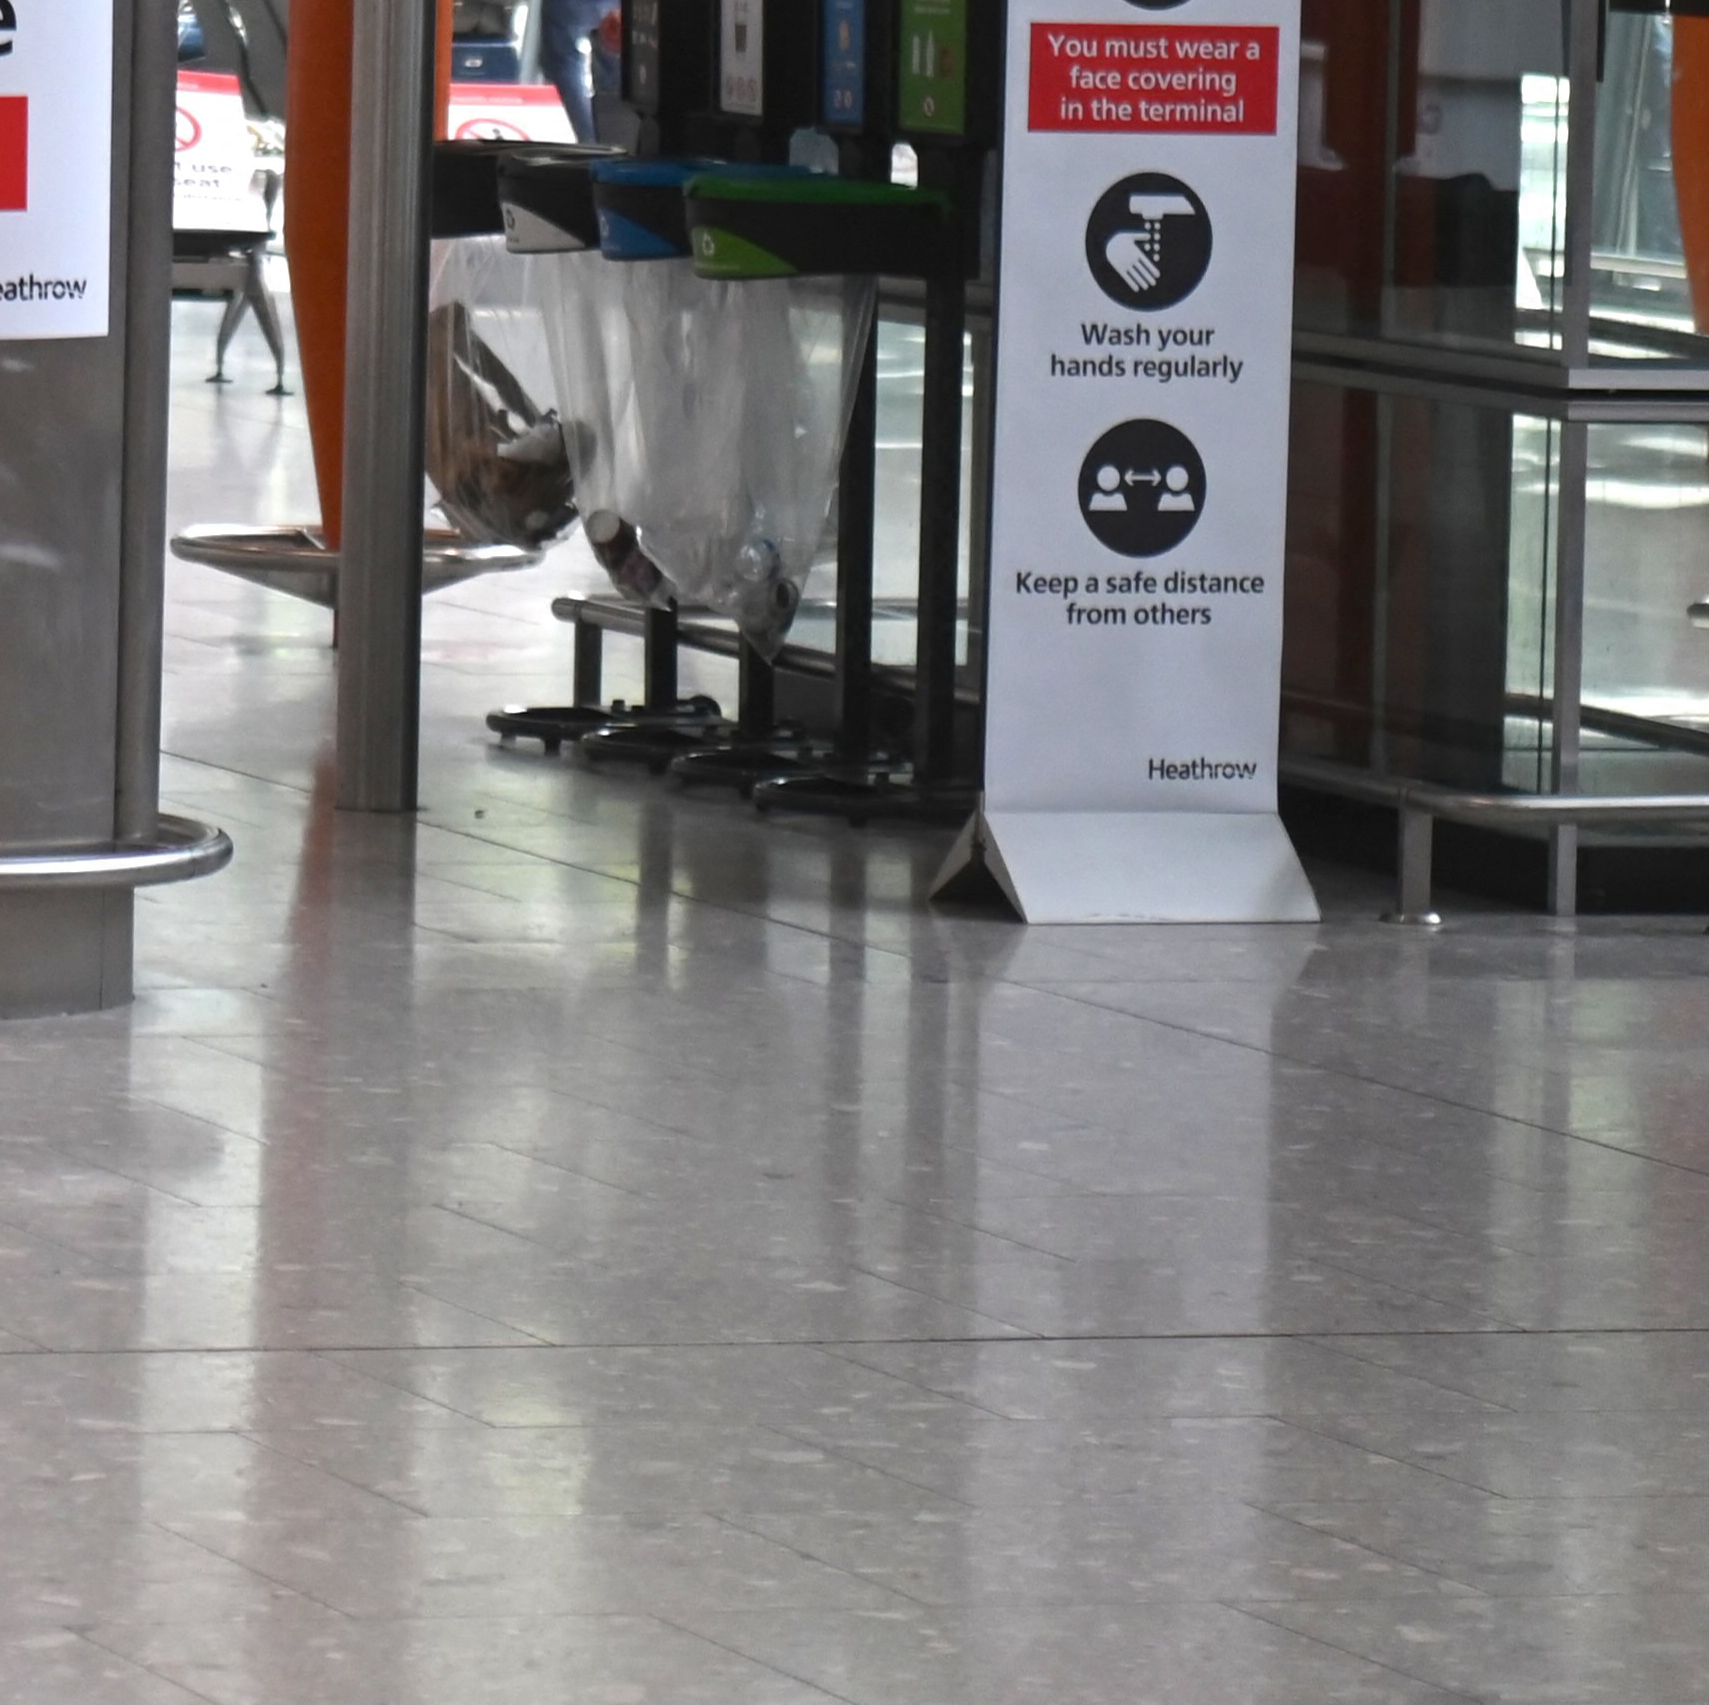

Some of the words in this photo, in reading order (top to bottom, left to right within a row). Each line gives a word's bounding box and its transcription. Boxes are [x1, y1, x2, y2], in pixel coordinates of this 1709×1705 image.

[1048, 35, 1098, 58] You
[1105, 37, 1169, 59] must
[1176, 41, 1240, 60] wear
[1245, 42, 1261, 60] a
[1070, 66, 1122, 90] face
[1128, 69, 1237, 96] covering
[1060, 99, 1084, 119] in
[1091, 100, 1132, 121] the
[1139, 100, 1244, 122] terminal
[192, 164, 232, 174] use
[1081, 322, 1150, 347] Wash
[1157, 324, 1215, 351] your
[1050, 354, 1126, 379] hands
[1133, 355, 1244, 383] regularly
[1016, 572, 1078, 599] Keep
[1086, 575, 1099, 594] a
[1106, 571, 1157, 594] safe
[1164, 572, 1265, 594] distance
[1066, 602, 1126, 625] from
[1133, 602, 1211, 625] others
[1148, 758, 1257, 782] Heathrow
